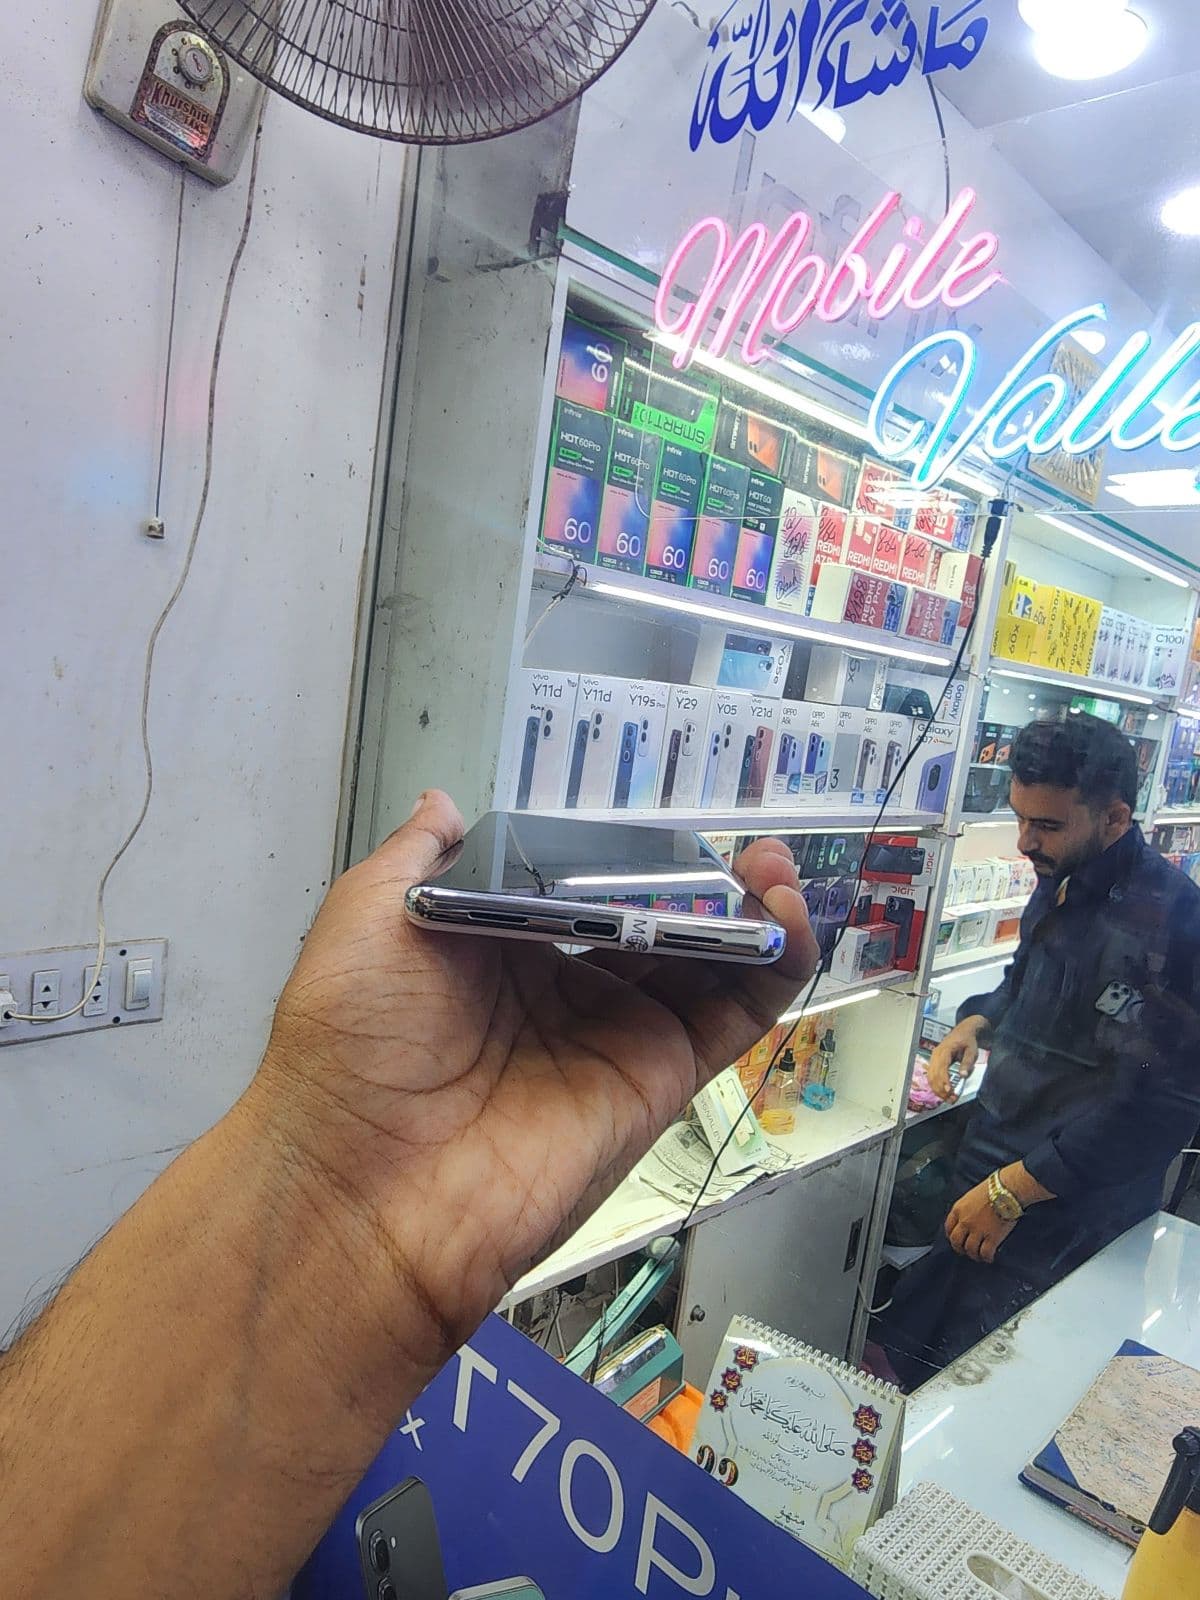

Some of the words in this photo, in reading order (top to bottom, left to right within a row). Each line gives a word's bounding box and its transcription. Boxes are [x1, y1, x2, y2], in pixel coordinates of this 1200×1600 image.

[151, 82, 210, 123] Khurshid
[654, 186, 1002, 371] Mobile
[653, 411, 706, 444] SMART
[564, 517, 592, 544] 60
[616, 532, 640, 557] 60
[816, 541, 841, 556] REDMI
[662, 546, 686, 569] 60
[847, 551, 871, 566] REDMI
[708, 558, 729, 580] 60
[873, 559, 897, 575] REDMI
[903, 566, 927, 581] REDMI
[745, 568, 765, 589] 60
[861, 580, 877, 622] REDMI
[533, 673, 549, 681] vivo
[583, 678, 599, 686] vivo
[532, 682, 562, 698] Y11d
[583, 687, 612, 703] Y11d
[629, 694, 656, 708] Y19s
[676, 696, 698, 710] Y29
[949, 683, 965, 720] Galaxy
[717, 703, 738, 716] Y05
[751, 705, 773, 718] Y21d
[917, 723, 954, 737] Galaxy
[830, 769, 839, 788] 3
[892, 886, 915, 895] DIGIT
